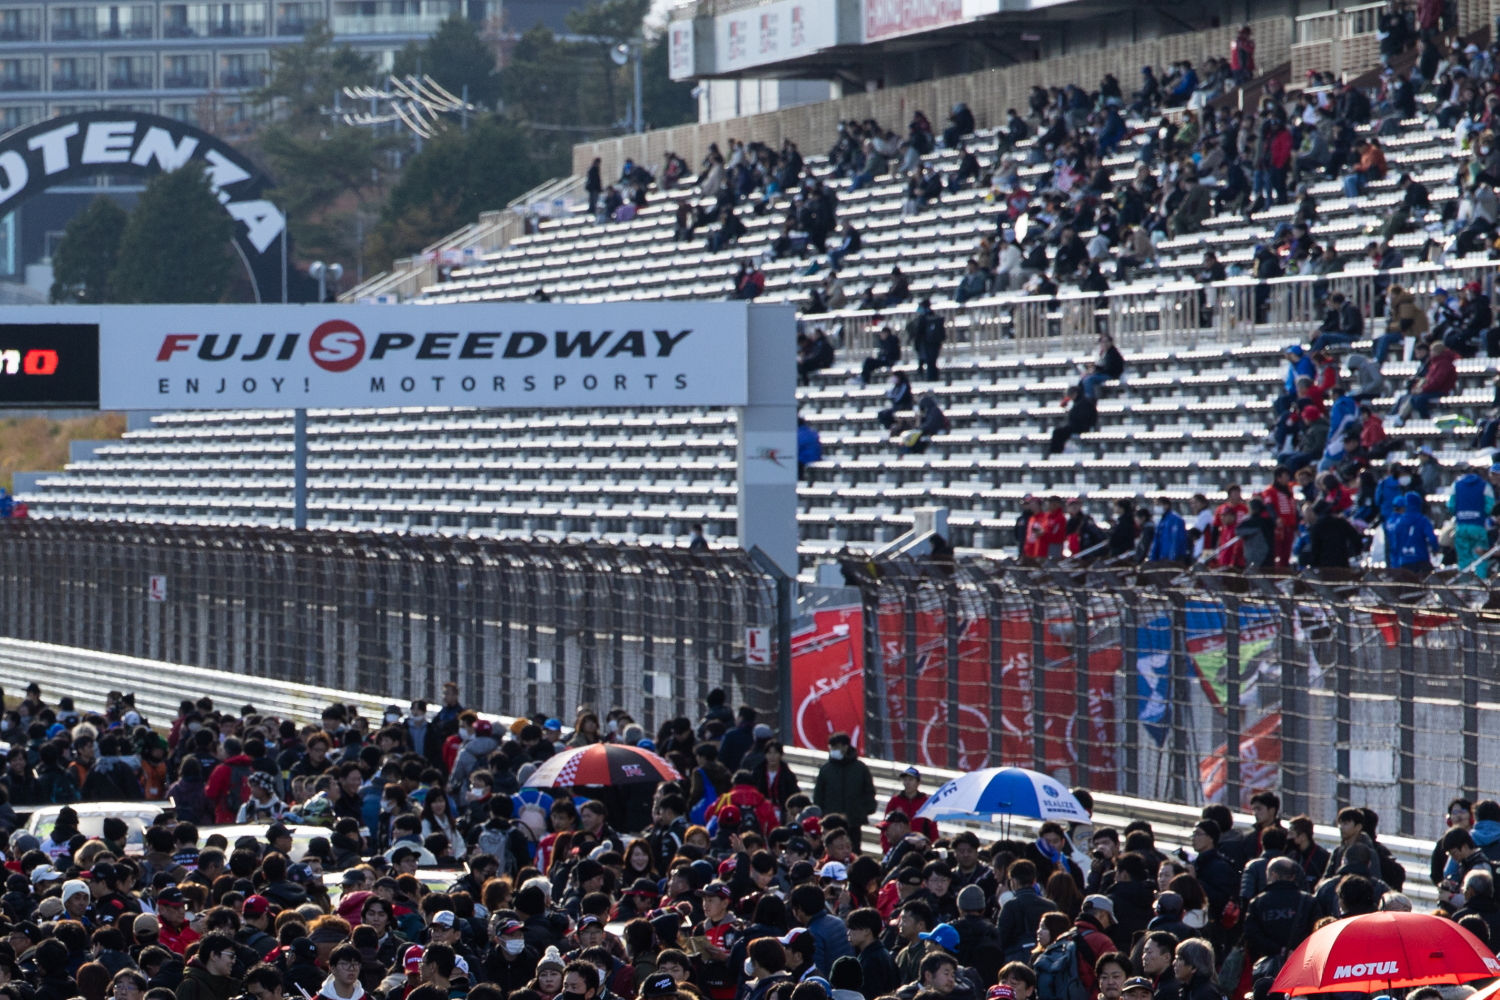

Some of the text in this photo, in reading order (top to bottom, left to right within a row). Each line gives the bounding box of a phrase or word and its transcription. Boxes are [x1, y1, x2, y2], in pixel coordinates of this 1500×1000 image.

[156, 319, 694, 373] FUJI SPEEDWAY
[157, 373, 689, 394] ENJOY! MOTORSPORTS
[1333, 961, 1399, 979] MOTUL
